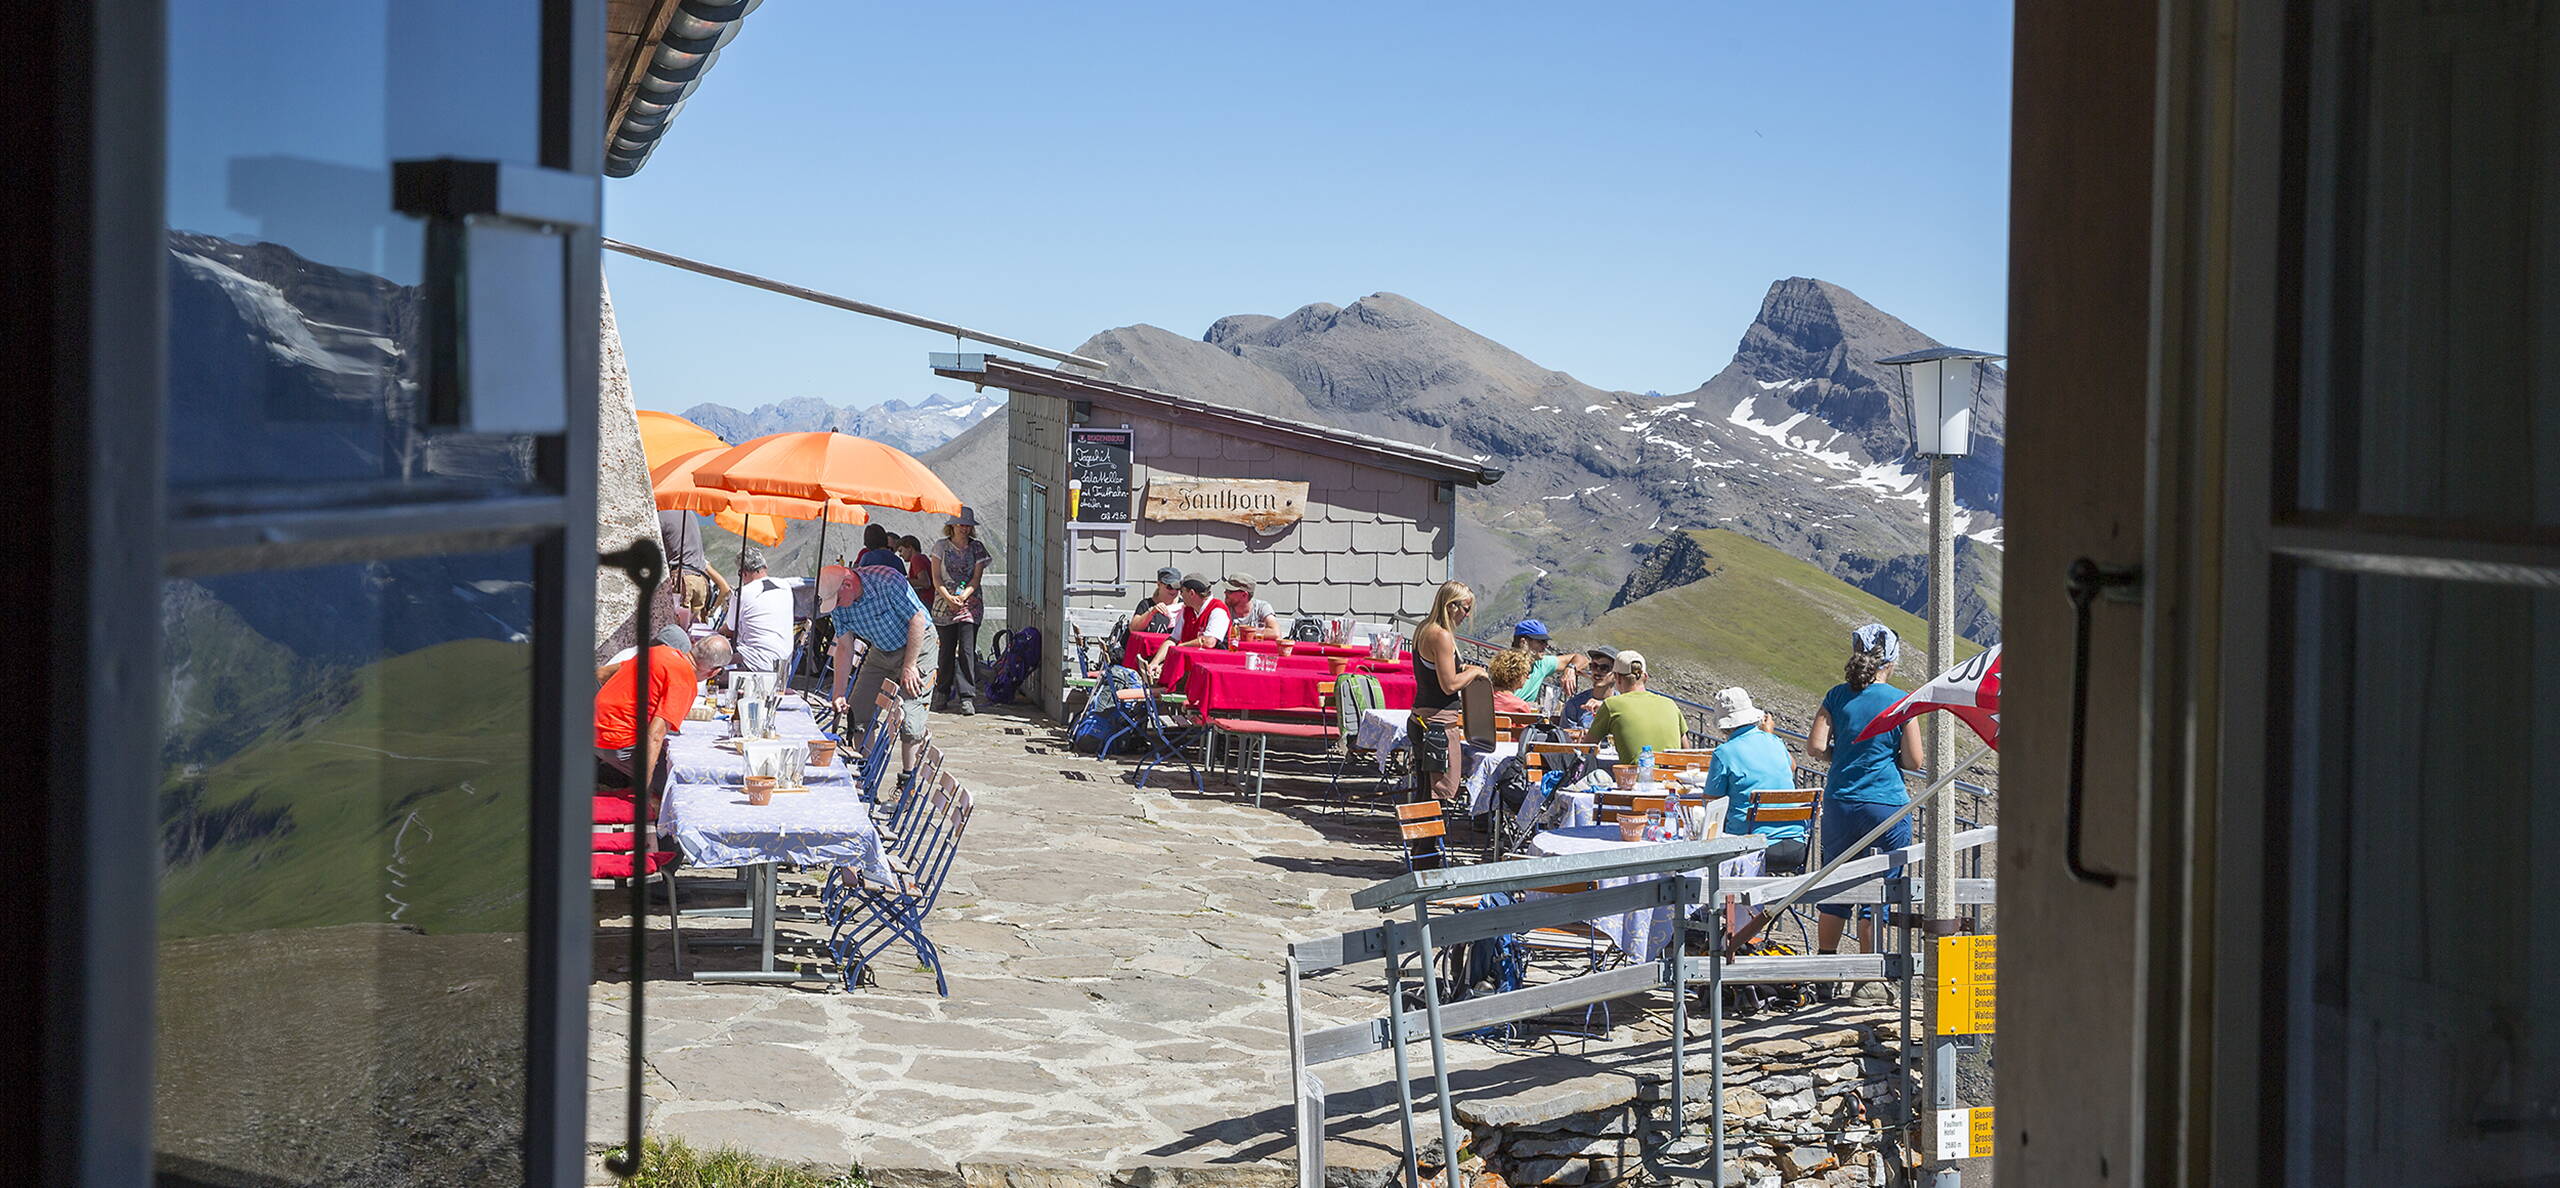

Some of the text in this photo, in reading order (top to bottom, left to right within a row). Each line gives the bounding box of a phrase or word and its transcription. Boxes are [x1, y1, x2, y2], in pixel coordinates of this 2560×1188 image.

[1178, 488, 1276, 511] Faulhorn
[1975, 1122, 1988, 1131] First
[1975, 1144, 1991, 1154] Axalp
